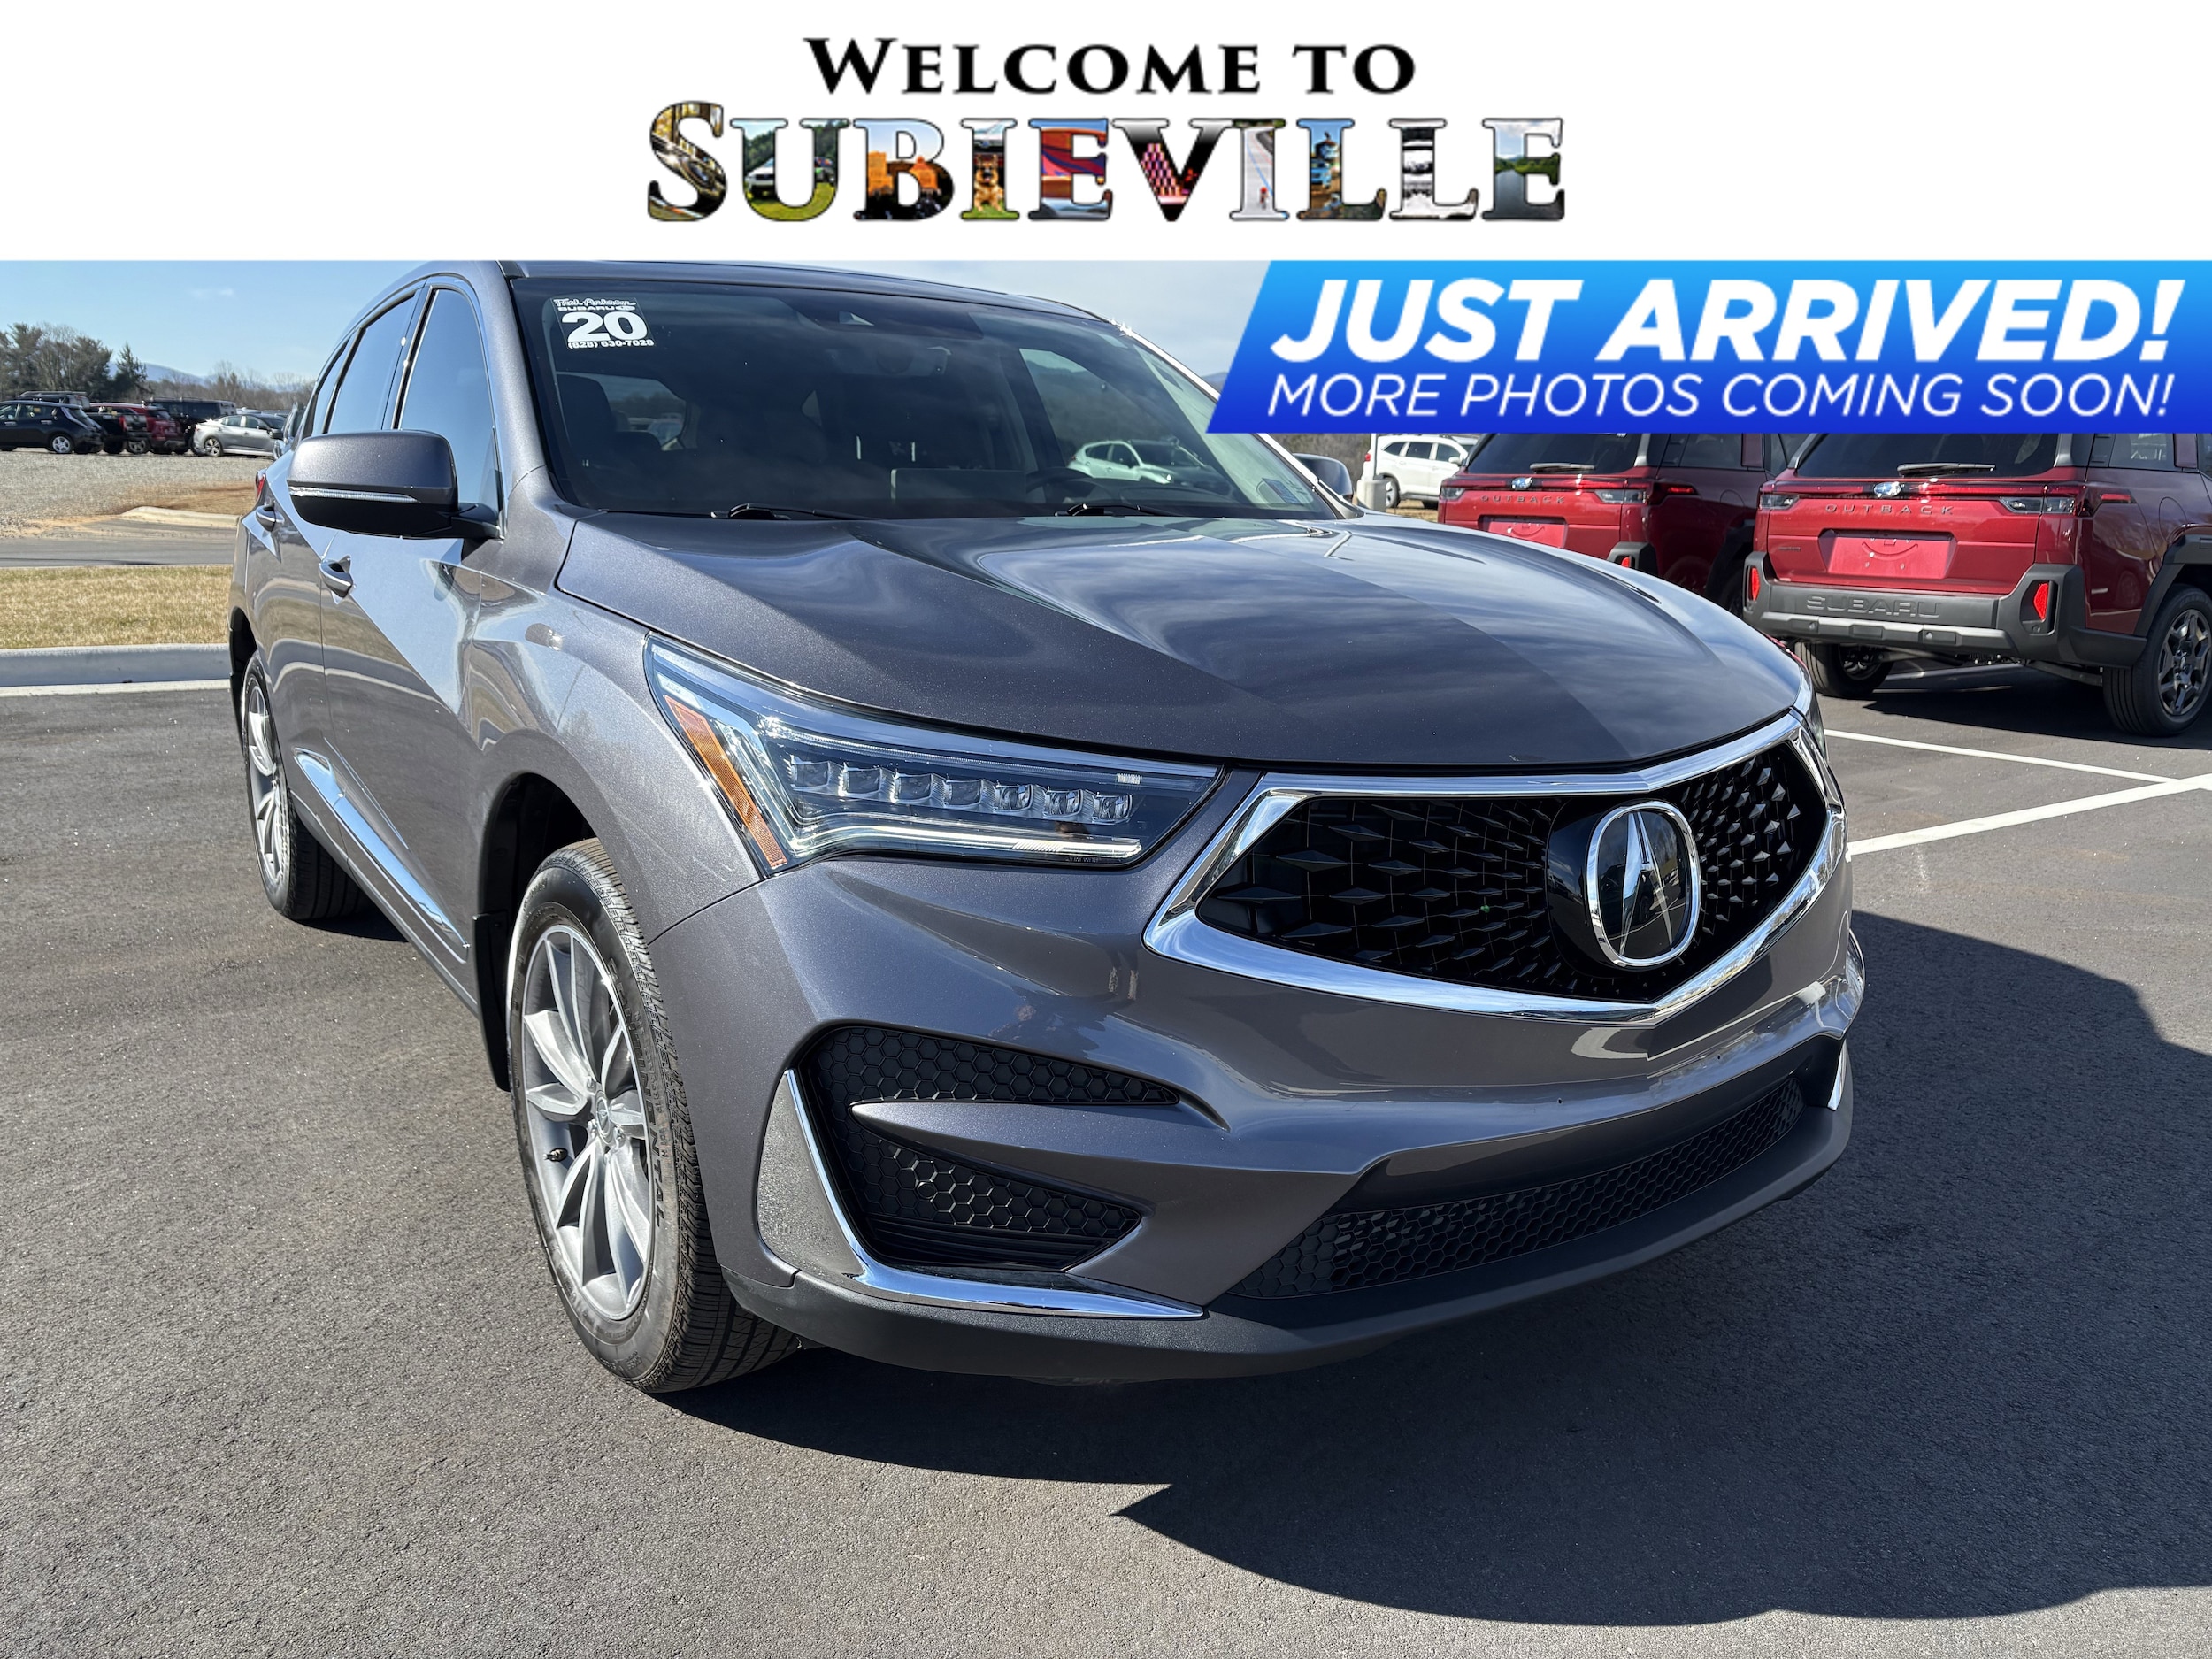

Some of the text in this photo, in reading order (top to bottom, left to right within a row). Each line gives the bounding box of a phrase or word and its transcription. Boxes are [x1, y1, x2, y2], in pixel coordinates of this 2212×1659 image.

[562, 311, 648, 342] 20
[568, 341, 598, 349] (828)
[1480, 495, 1565, 504] OUTBACK
[1824, 503, 1955, 516] OUTBACK
[1806, 595, 1943, 619] SUBARU
